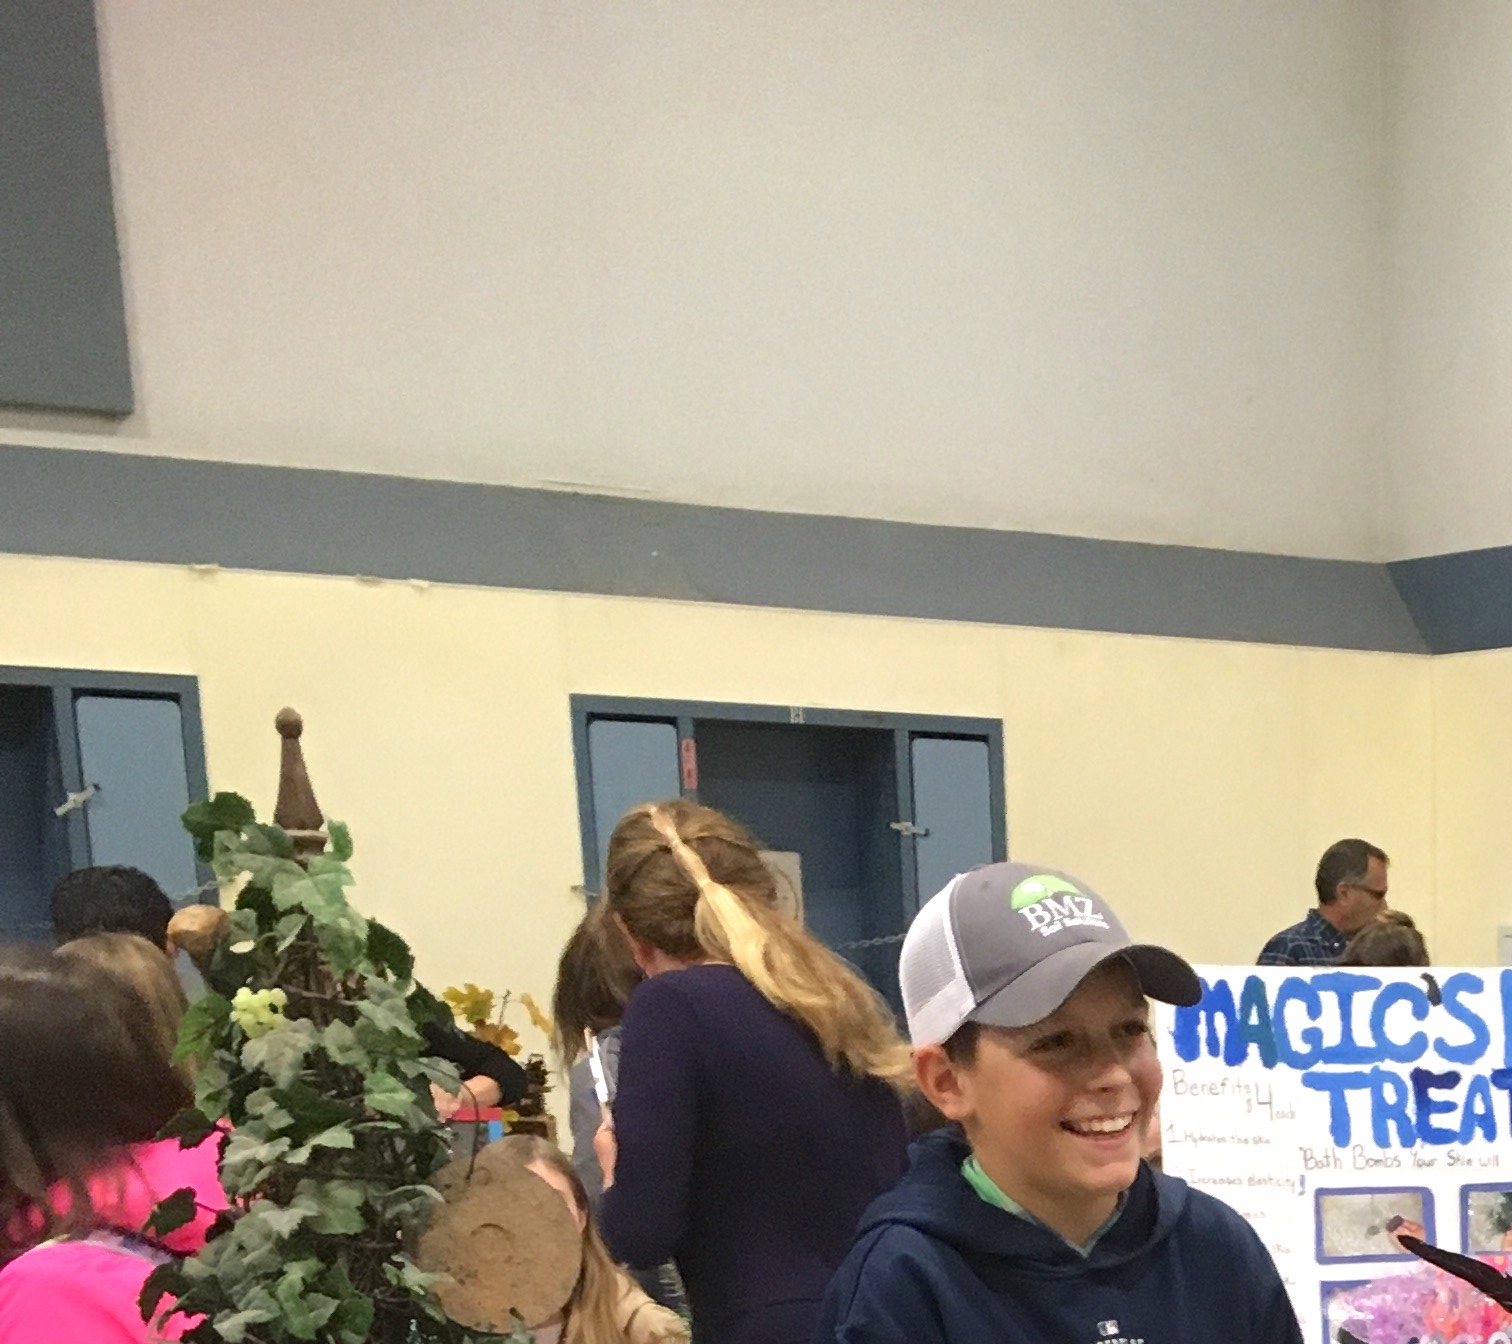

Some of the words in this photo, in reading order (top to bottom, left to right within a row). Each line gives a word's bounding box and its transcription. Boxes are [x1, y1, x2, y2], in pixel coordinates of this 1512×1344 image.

[1018, 895, 1104, 932] BMZ
[1173, 972, 1491, 1070] MAGIC'S
[1301, 1145, 1342, 1171] Bath
[1352, 1143, 1402, 1171] Bombs
[1409, 1147, 1439, 1170] Your
